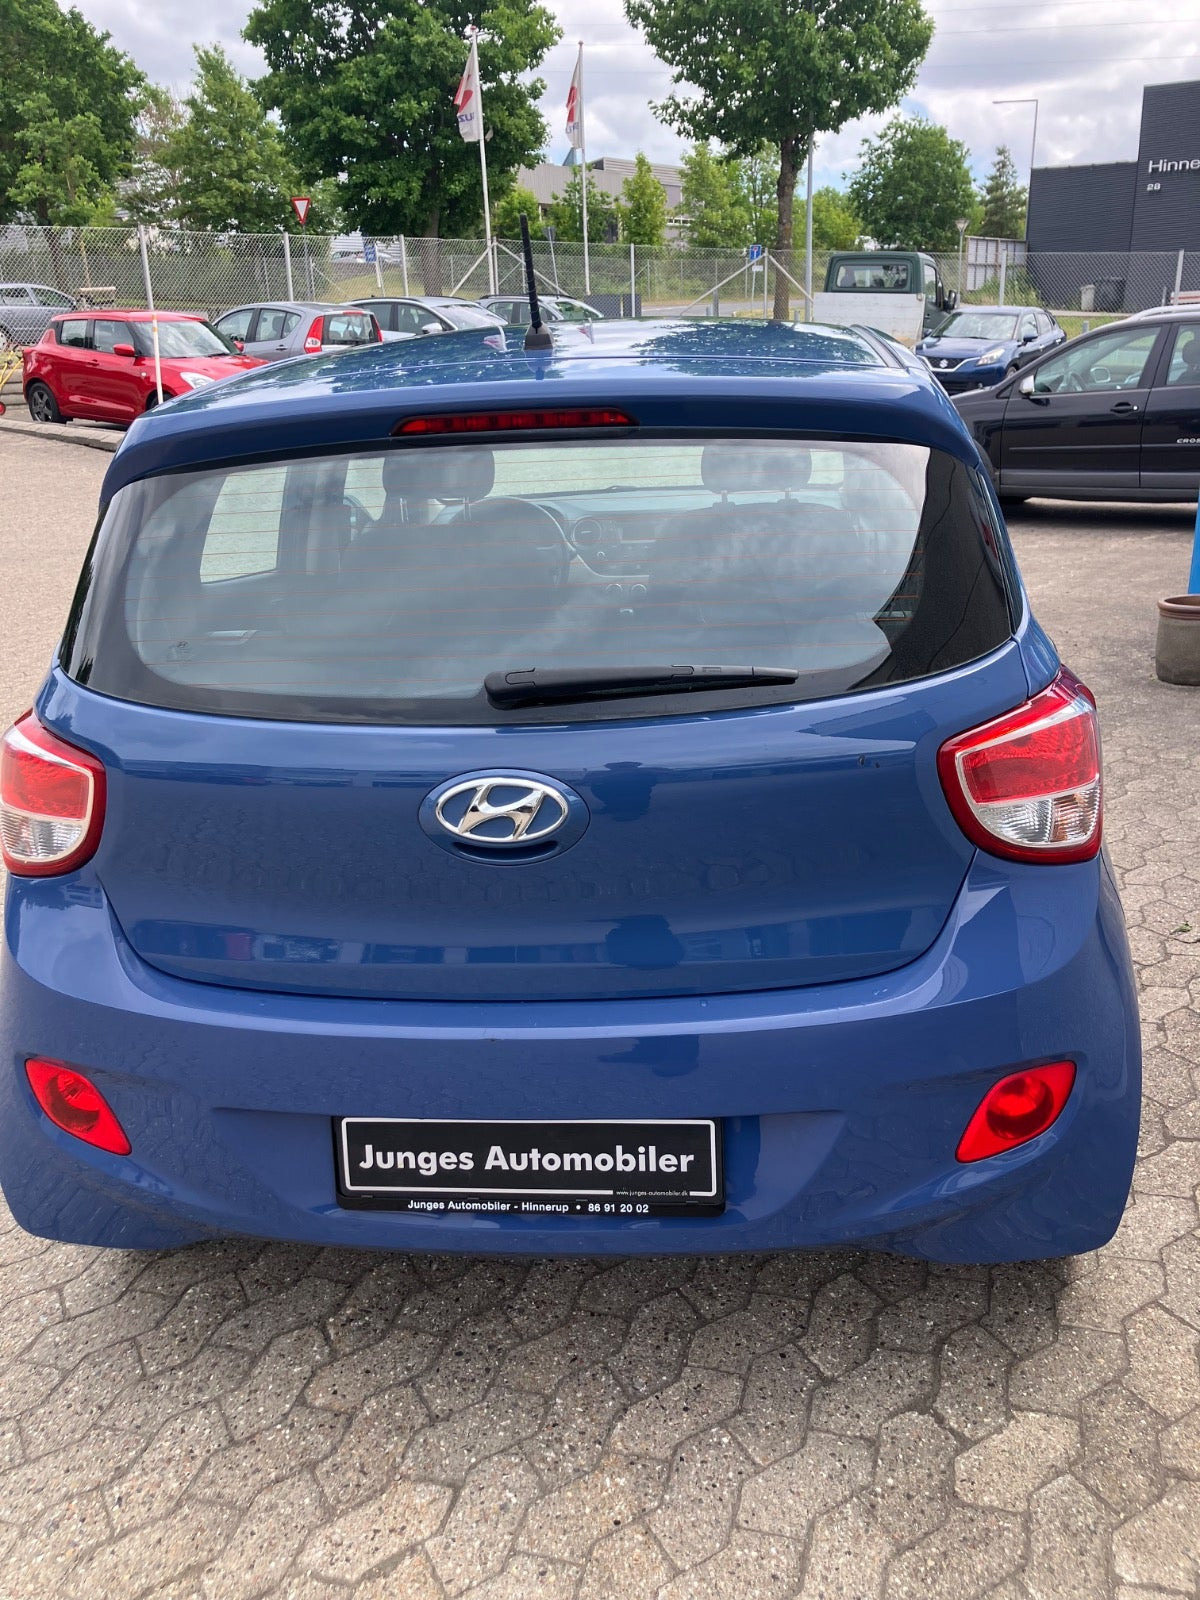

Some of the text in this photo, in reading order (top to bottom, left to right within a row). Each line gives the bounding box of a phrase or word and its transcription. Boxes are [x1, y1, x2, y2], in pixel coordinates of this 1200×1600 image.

[1148, 159, 1200, 173] Hinne
[1147, 183, 1161, 191] 28
[359, 1144, 695, 1176] Junges Automobiler
[407, 1200, 445, 1211] Junges
[448, 1201, 511, 1211] Automobiler
[521, 1202, 569, 1213] Hinnerup
[588, 1203, 601, 1212] 86
[604, 1203, 616, 1212] 91
[620, 1203, 633, 1213] 20
[636, 1204, 649, 1213] 02
